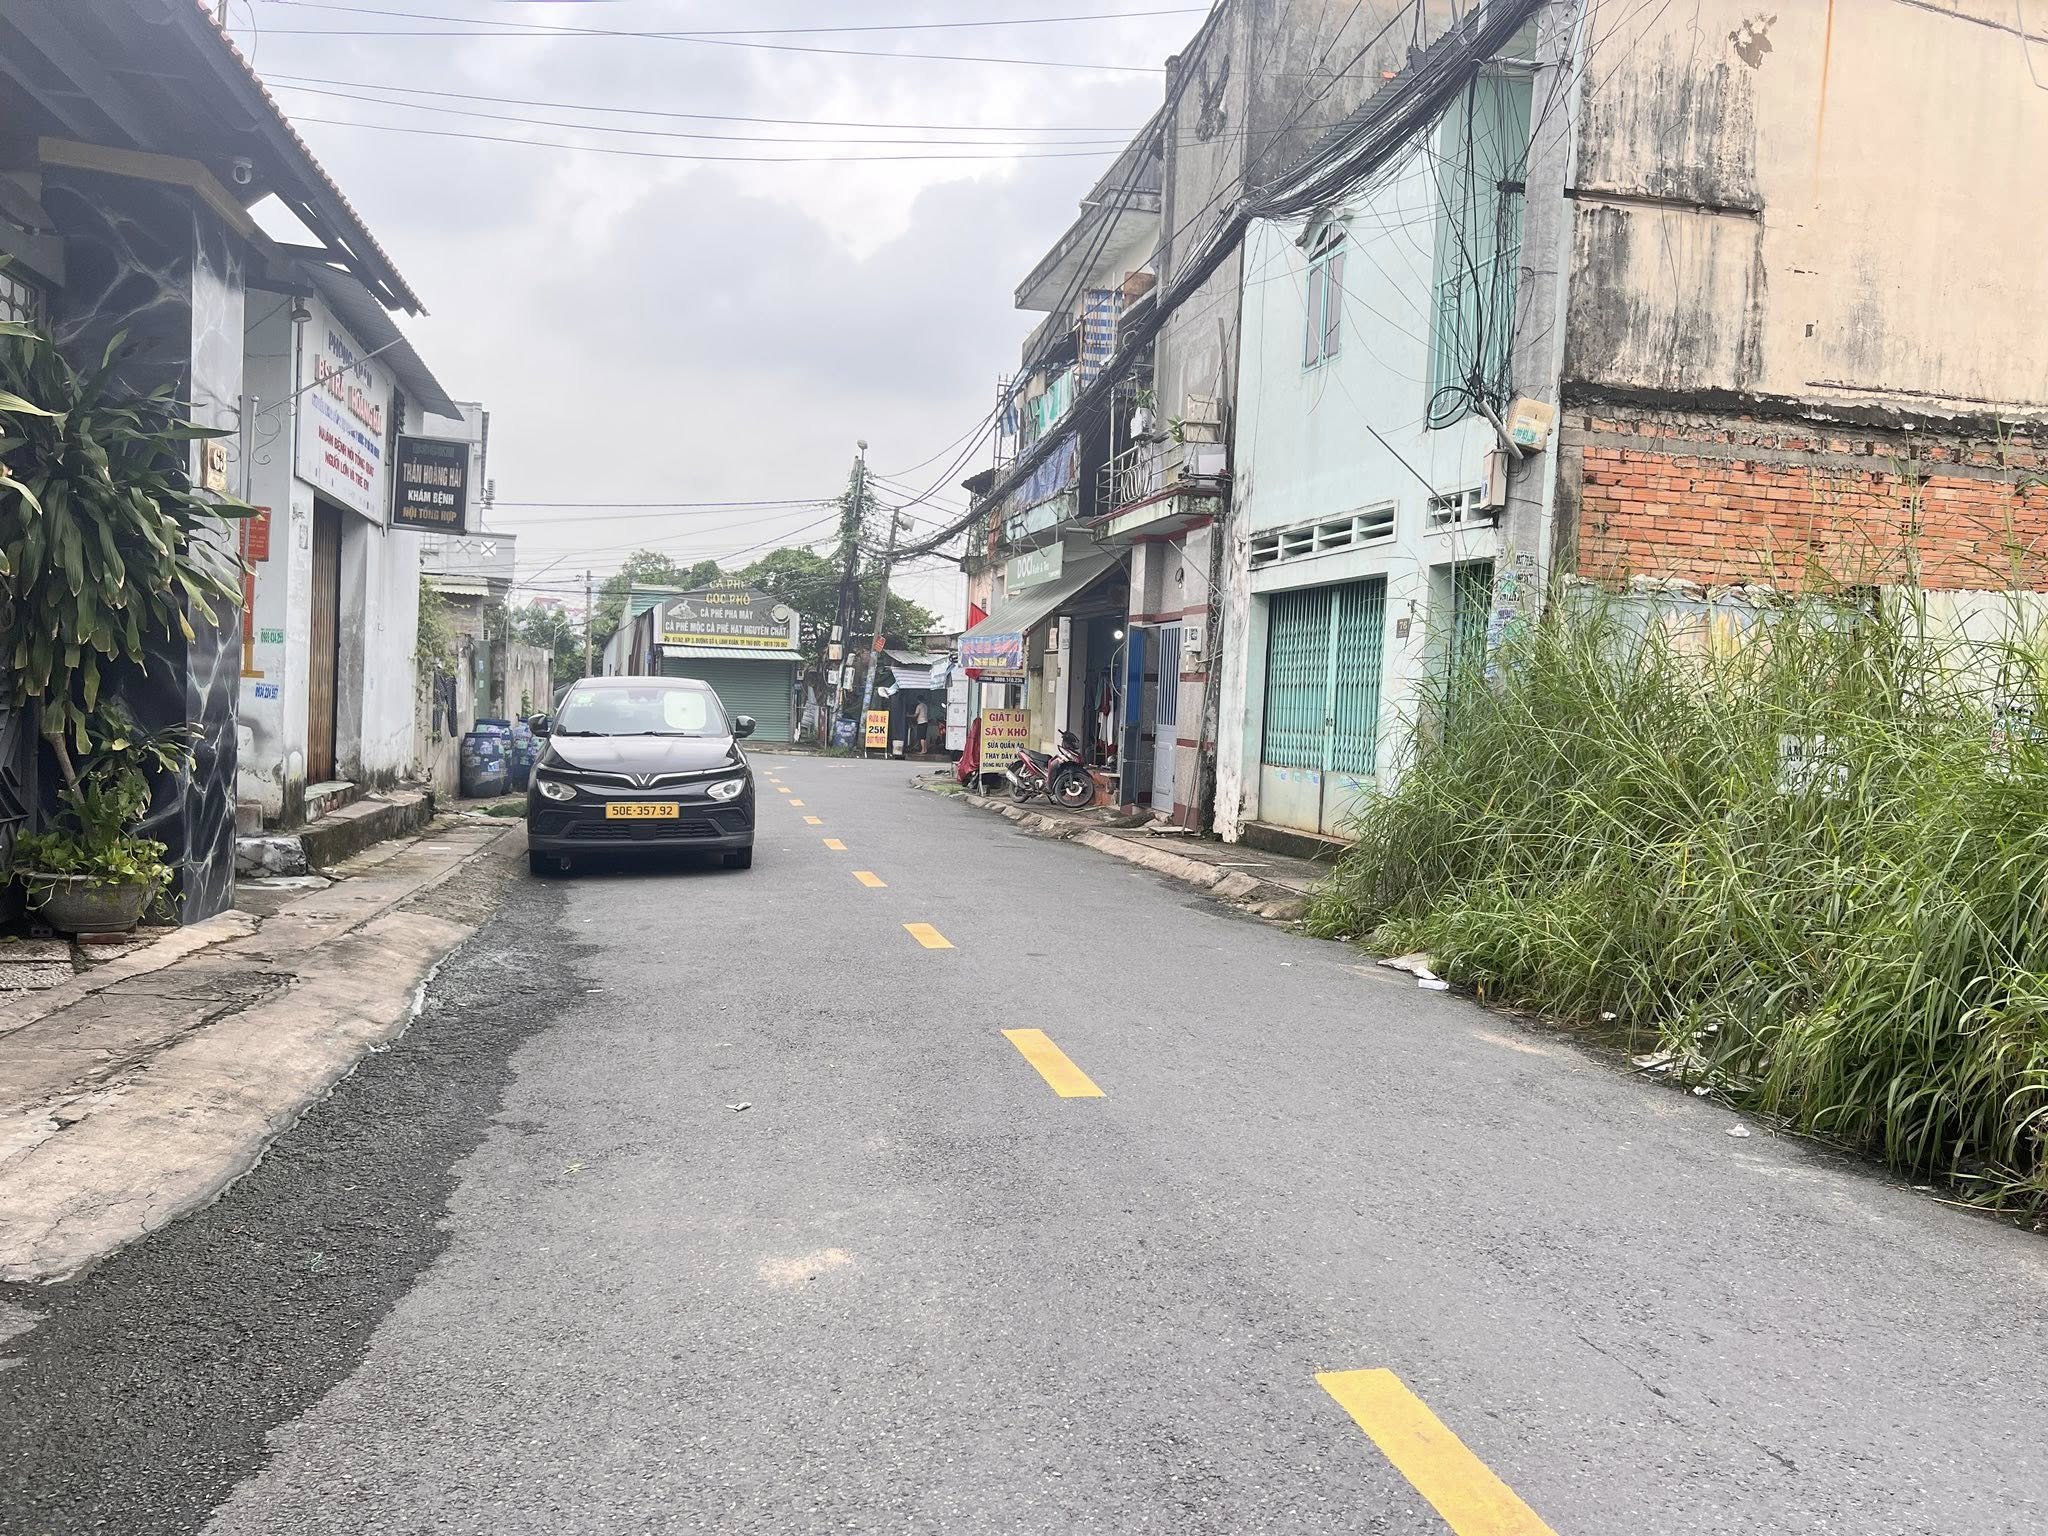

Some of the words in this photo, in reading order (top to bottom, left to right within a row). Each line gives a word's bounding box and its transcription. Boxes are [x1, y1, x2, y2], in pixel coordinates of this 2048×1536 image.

[423, 462, 448, 487] HOÀNG
[449, 462, 462, 488] HẢI
[407, 488, 431, 503] KHÁM
[432, 490, 455, 507] BỆNH
[402, 505, 417, 520] NỘI
[700, 607, 709, 618] CÀ
[711, 608, 723, 619] PHÊ
[725, 609, 737, 619] PHA
[739, 609, 753, 620] MÁY
[665, 620, 674, 631] CÀ
[676, 621, 689, 632] PHÊ
[690, 621, 705, 634] MỘC
[706, 622, 715, 633] CÀ
[717, 623, 729, 634] PHÊ
[731, 624, 742, 636] HẠT
[744, 624, 769, 636] NGUYÊN
[770, 624, 786, 637] CHẤT
[1014, 711, 1024, 722] ỦI
[869, 725, 885, 734] 25K
[1007, 726, 1028, 737] KHÔ
[987, 740, 998, 749] SỬA
[999, 740, 1015, 749] QUẦN
[612, 806, 673, 816] 50E-357.92
